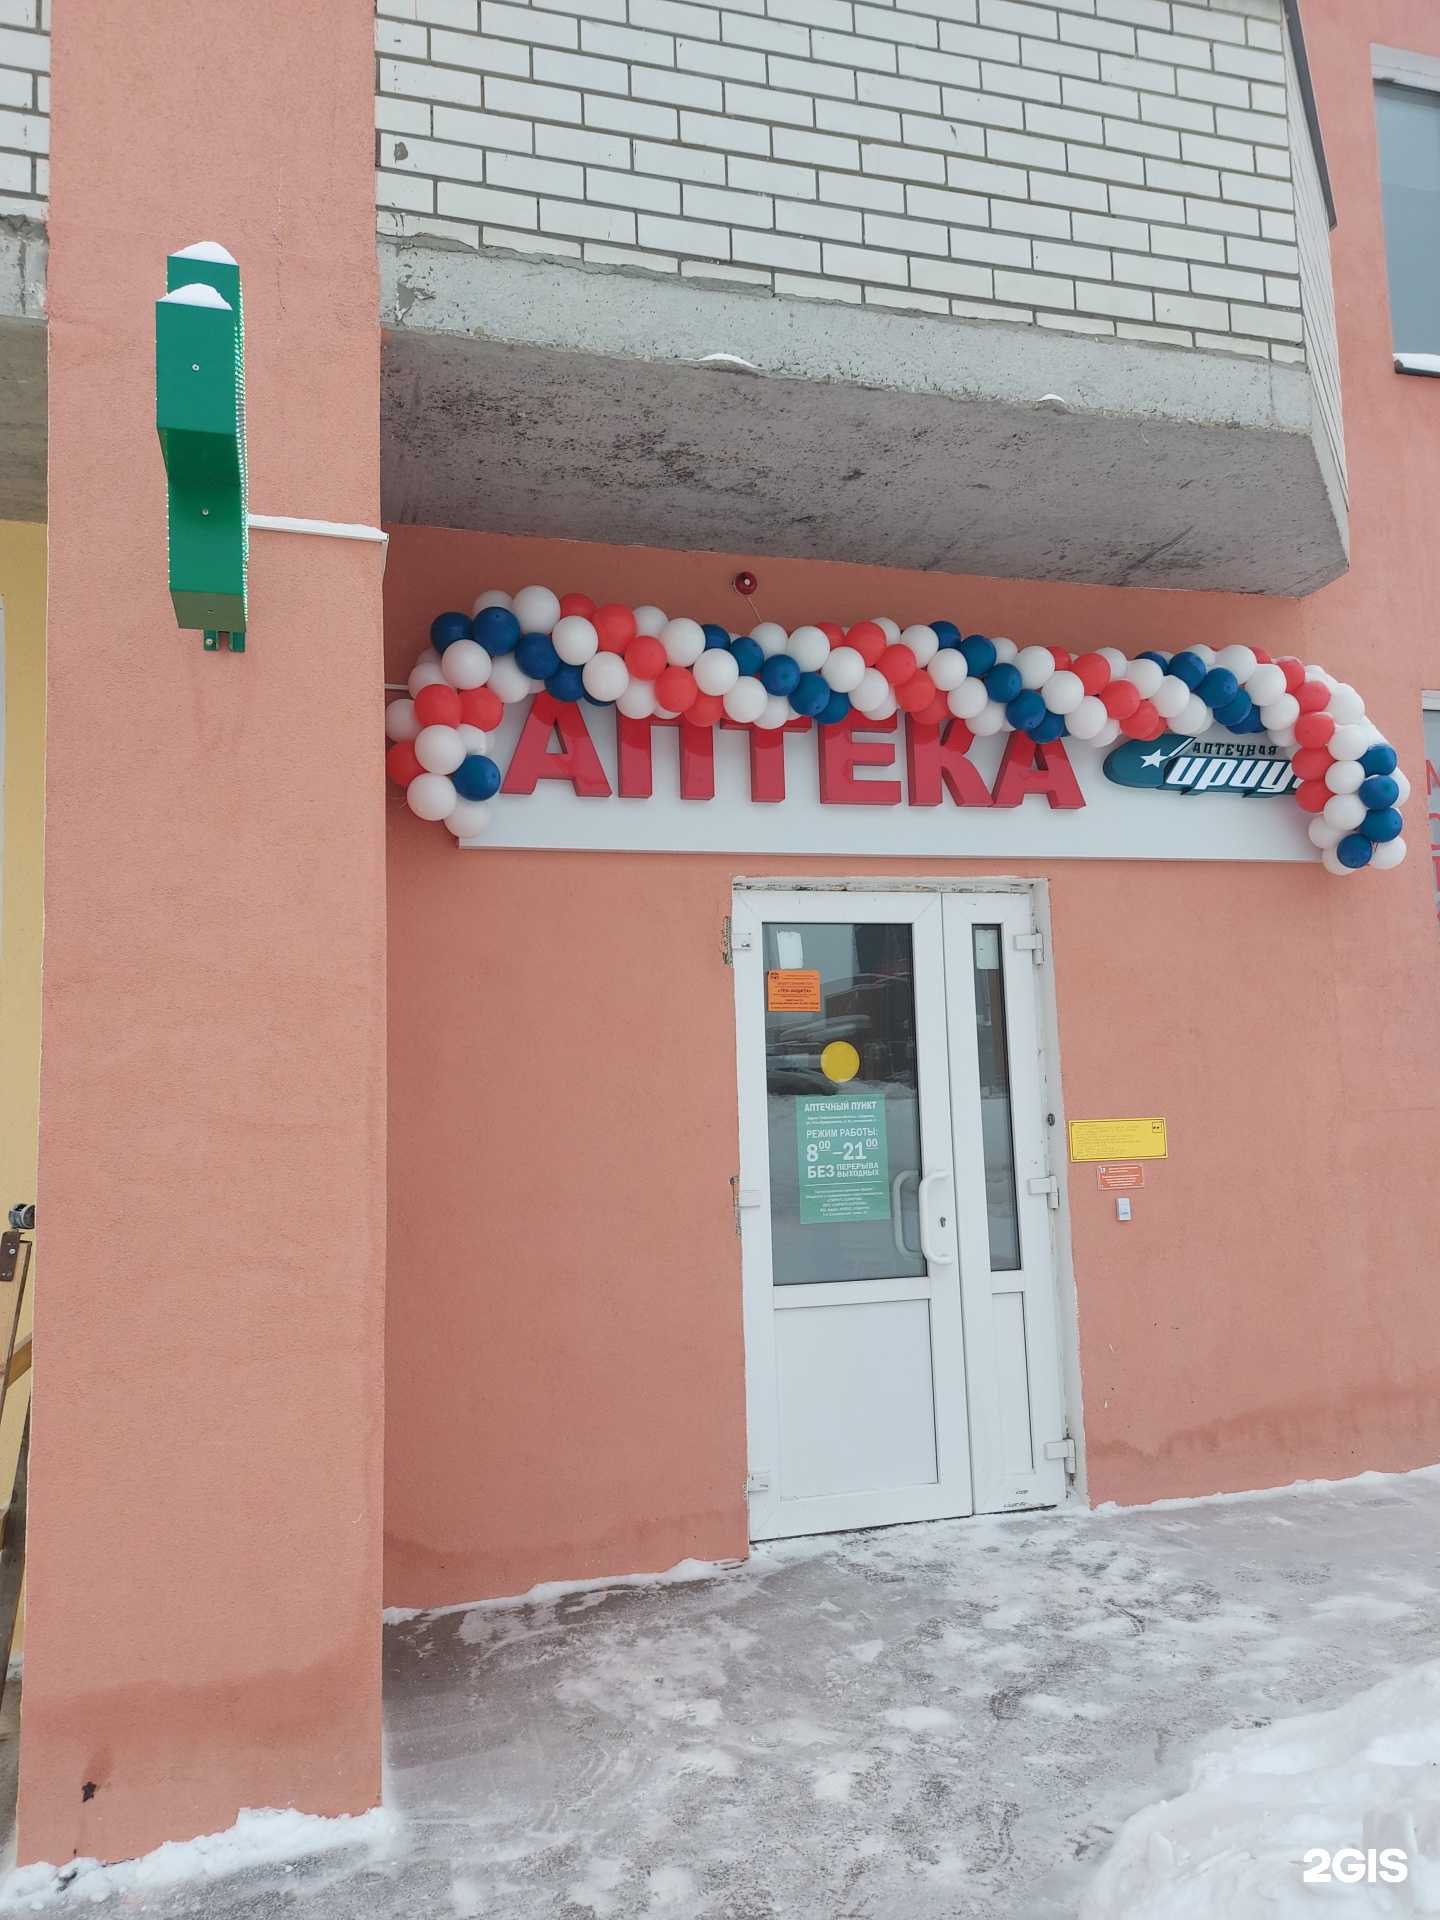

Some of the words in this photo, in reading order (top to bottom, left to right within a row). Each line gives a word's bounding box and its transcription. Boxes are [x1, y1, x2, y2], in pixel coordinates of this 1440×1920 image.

[500, 690, 1086, 809] АПТЕКА
[1192, 742, 1279, 756] АПТЕЧНАЯ
[804, 1101, 850, 1112] АПТЕЧНЫЙ
[851, 1100, 877, 1110] ПУНКТ
[806, 1129, 838, 1138] РЕЖИМ
[840, 1127, 878, 1137] РАБОТЫ:
[807, 1164, 835, 1178] БЕЗ
[836, 1162, 879, 1170] ПЕРЕРЫВА
[836, 1169, 879, 1178] ВЫХОДНЫХ
